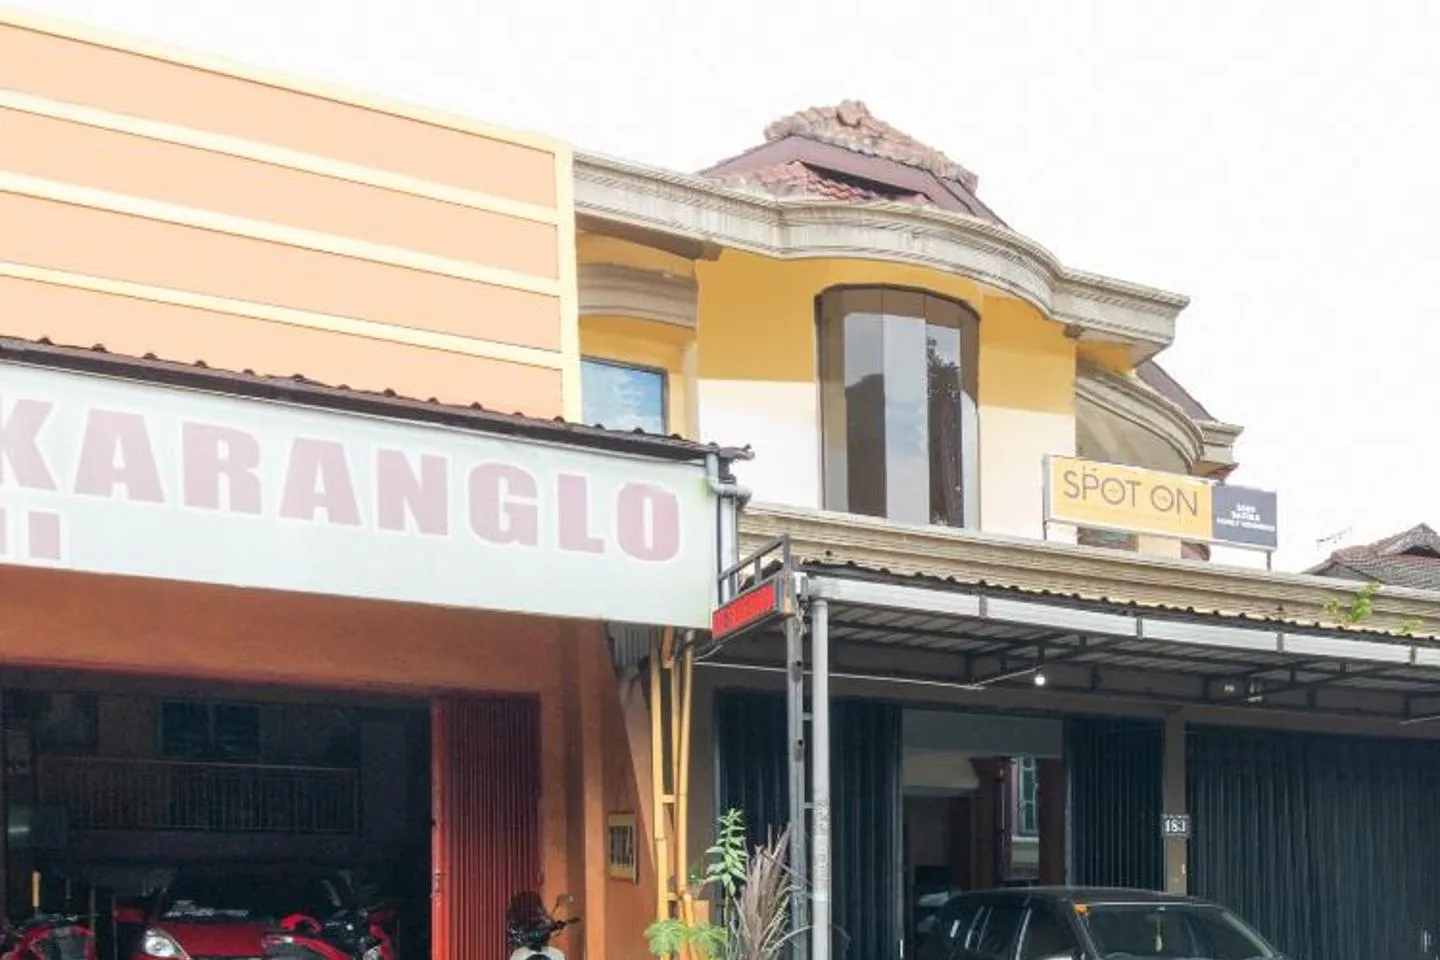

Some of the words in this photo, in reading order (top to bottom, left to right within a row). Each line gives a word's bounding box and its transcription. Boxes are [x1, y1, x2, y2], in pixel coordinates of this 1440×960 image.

[0, 397, 681, 562] KARANGLO
[1063, 467, 1141, 508] SPOT
[1150, 484, 1197, 517] ON
